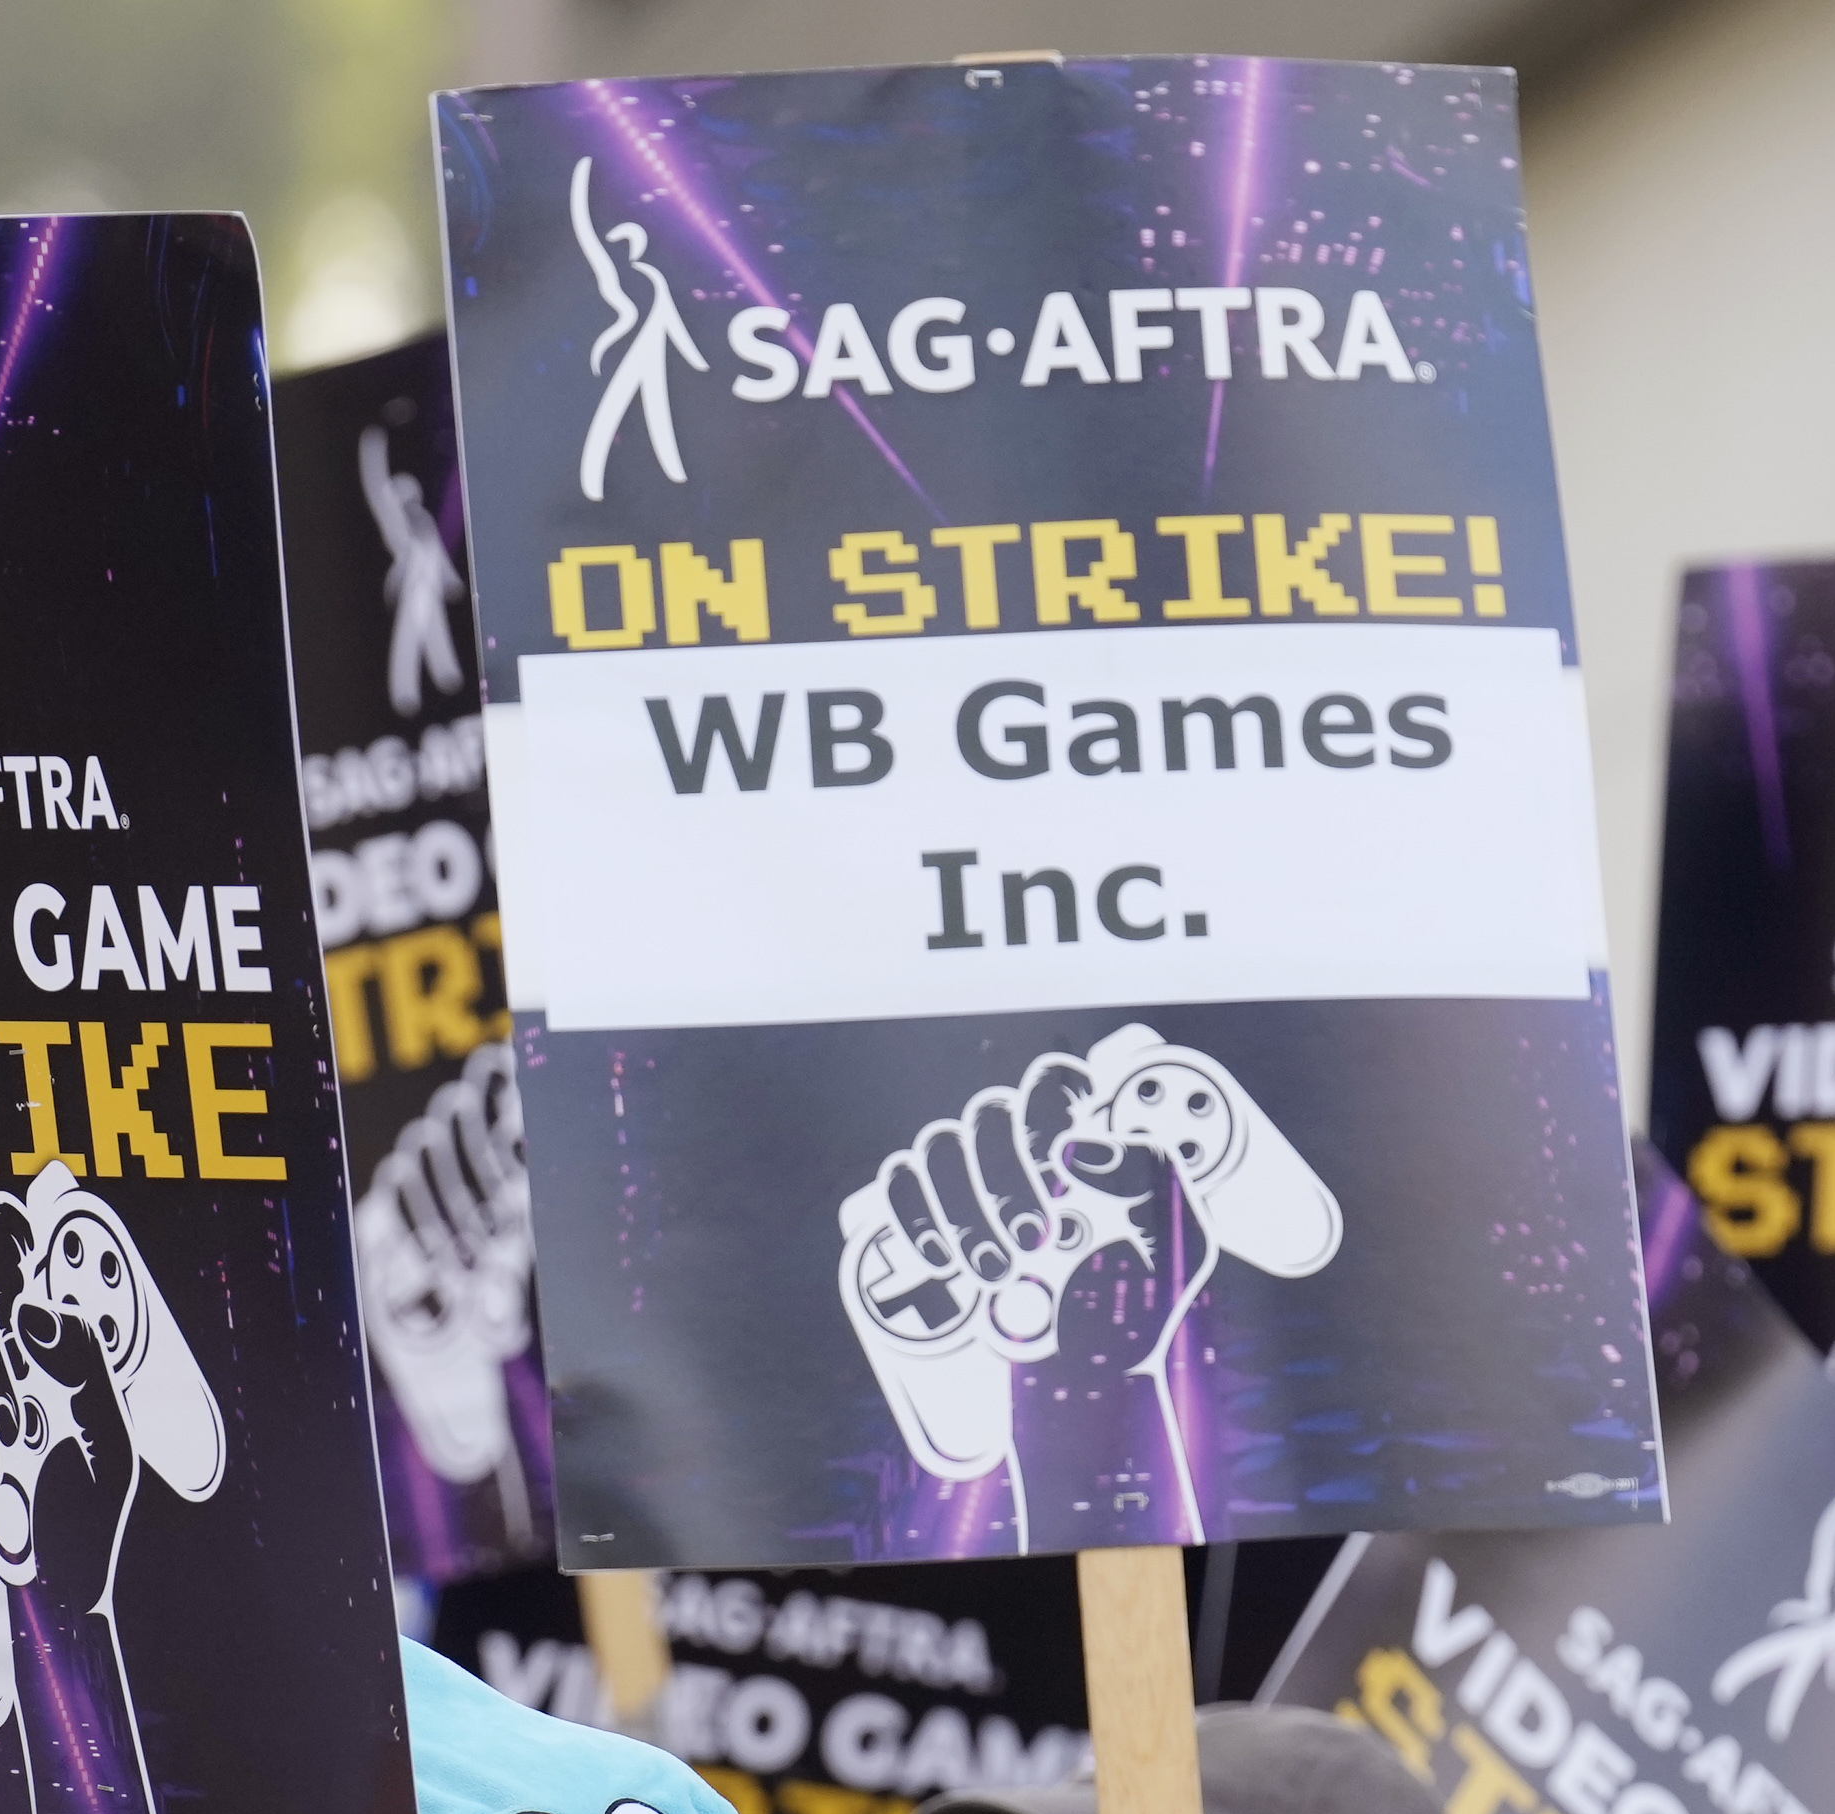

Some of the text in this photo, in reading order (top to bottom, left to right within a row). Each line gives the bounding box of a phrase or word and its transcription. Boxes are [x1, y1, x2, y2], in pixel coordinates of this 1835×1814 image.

[547, 511, 1508, 651] ON STRIKE!
[643, 677, 1454, 796] WB Games
[13, 882, 274, 993] GAME
[918, 848, 1211, 950] Inc.
[820, 1693, 1094, 1796] GAM
